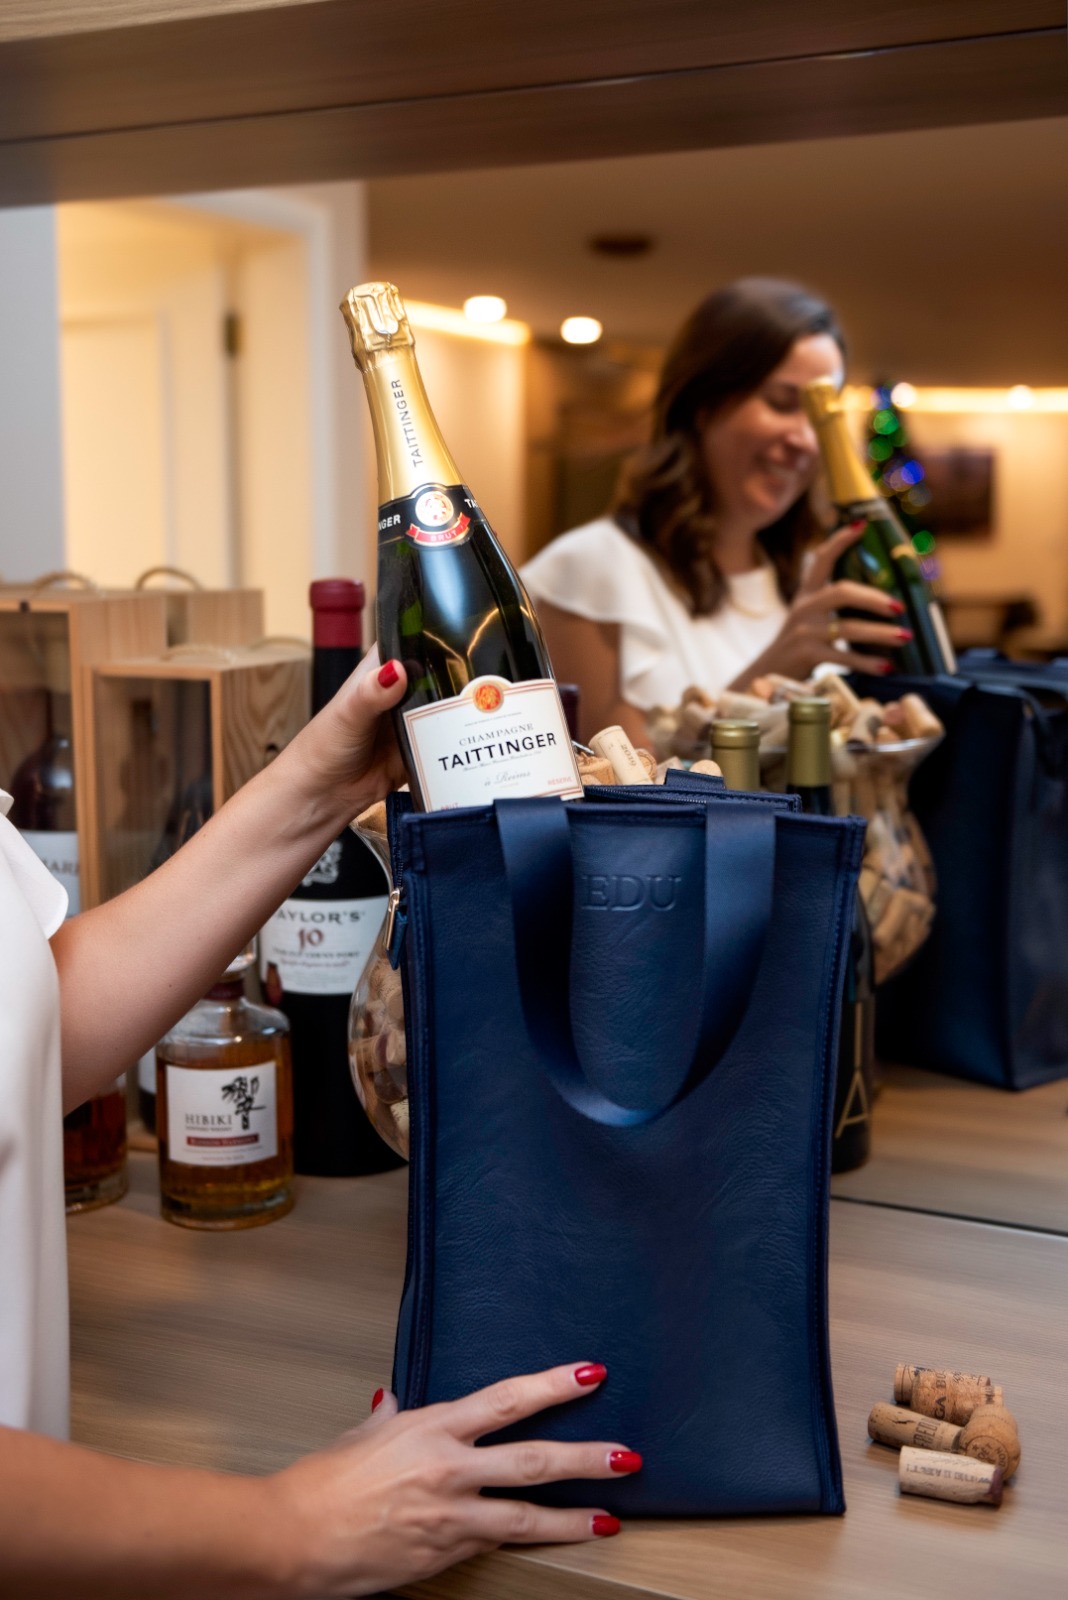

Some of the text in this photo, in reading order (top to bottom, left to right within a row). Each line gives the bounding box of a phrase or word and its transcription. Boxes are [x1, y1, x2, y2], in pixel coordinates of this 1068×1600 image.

[391, 379, 424, 468] TAITTINGER
[430, 531, 457, 542] BRUT
[458, 723, 535, 747] CHAMPAGNE
[438, 732, 557, 772] TAITTINGER
[620, 743, 637, 767] 2019
[580, 875, 682, 912] EDU
[298, 928, 325, 950] 10
[185, 1113, 232, 1126] HIBIKI
